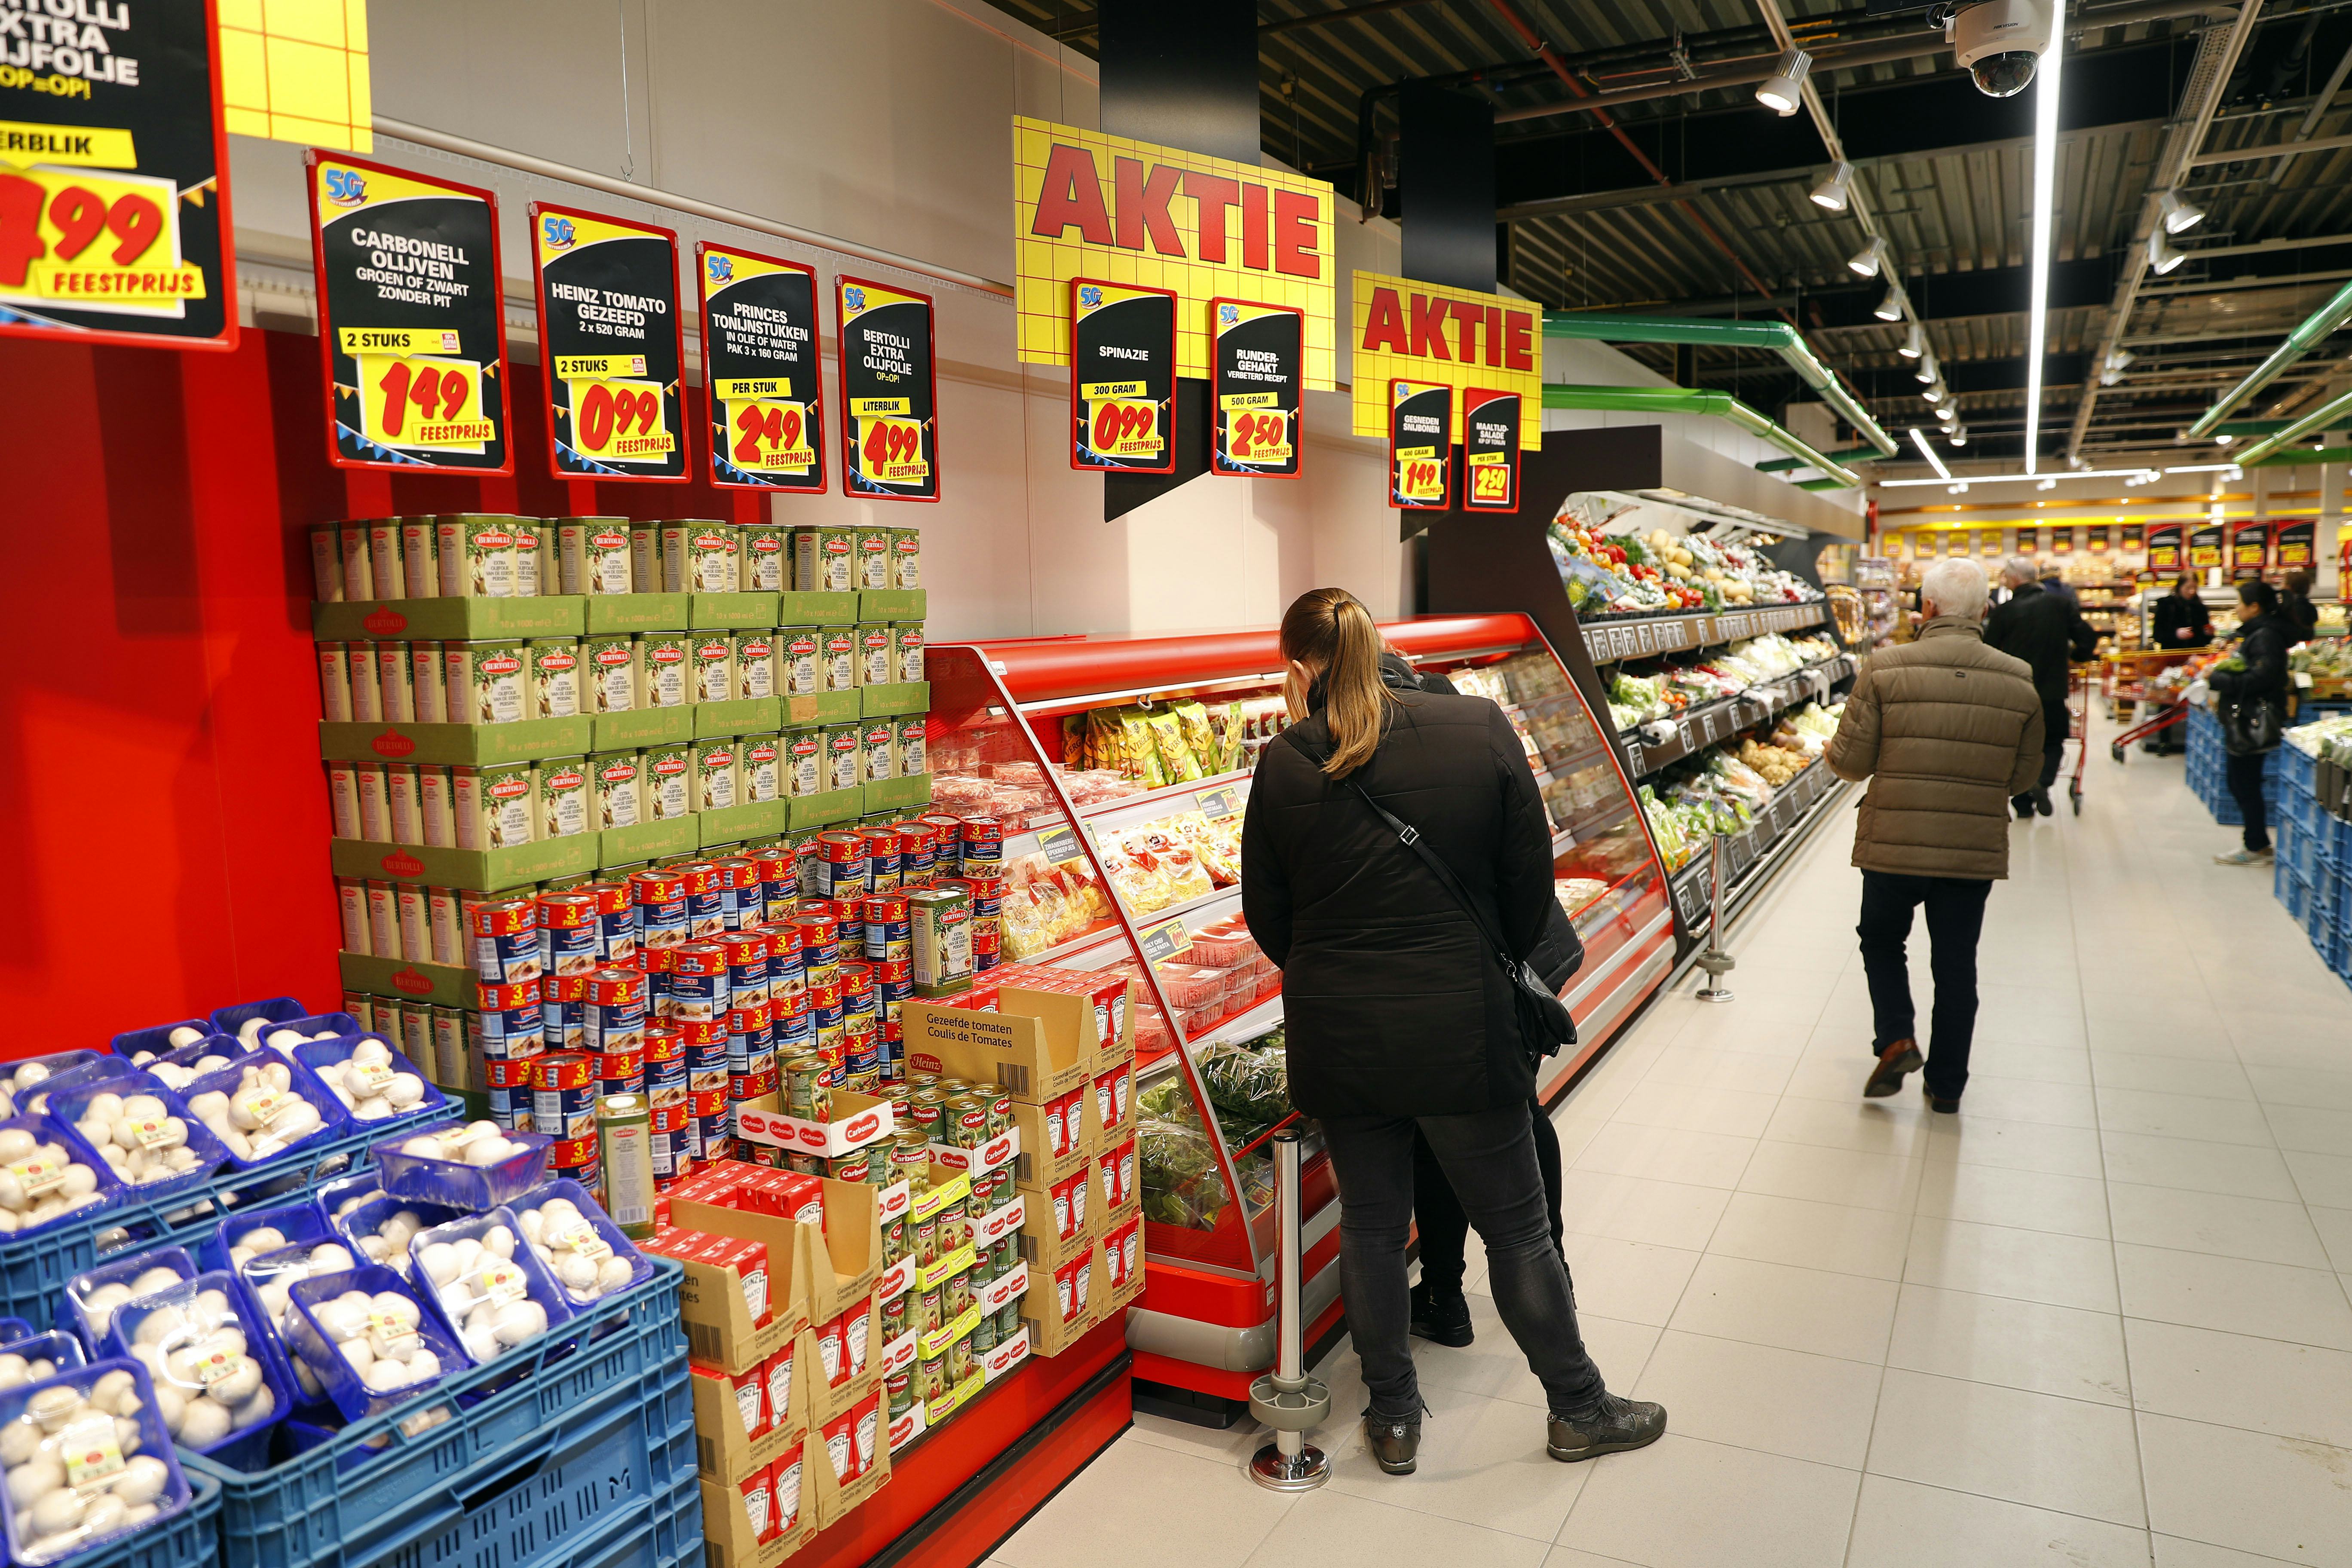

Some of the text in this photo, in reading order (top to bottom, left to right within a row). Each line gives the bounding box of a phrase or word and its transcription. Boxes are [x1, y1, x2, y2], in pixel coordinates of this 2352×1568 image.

[0, 3, 110, 54] XTRA
[0, 64, 91, 100] OP=OP!
[1031, 143, 1320, 277] AKTIE
[351, 227, 469, 265] CARBONELL
[371, 250, 454, 280] OLIJVEN
[54, 273, 194, 293] FEESTPRIJS
[356, 266, 469, 297] GROEN OF ZWART
[377, 285, 452, 308] ZONDER PIT
[551, 282, 666, 315] HEINZ TOMATO
[578, 303, 646, 327] GEZEEFD
[734, 303, 787, 324] PRINCES
[579, 321, 586, 332] 2
[596, 322, 613, 336] 520
[615, 325, 645, 339] GRAM
[712, 313, 808, 341] TONIJNSTUKKEN
[1362, 287, 1533, 371] AKTIE
[347, 333, 410, 347] 2 STUKS
[726, 331, 797, 351] IN OLIE OF WATER
[863, 329, 910, 349] BERTOLLI
[727, 343, 743, 355] PAK
[744, 346, 749, 356] 3
[758, 348, 772, 359] 160
[773, 349, 797, 362] GRAM
[870, 343, 905, 361] EXTRA
[1099, 346, 1148, 361] SPINAZIE
[1237, 349, 1280, 363] RUNDER-
[560, 360, 608, 373] 2 STUKS
[863, 355, 912, 375] OLIJFOLIE
[1238, 361, 1278, 374] GEHAKT
[876, 371, 900, 383] OP=OP!
[1227, 371, 1288, 383] VERBETERD RECEPT
[732, 381, 777, 393] PER STUK
[1094, 384, 1136, 395] 300 GRAM
[379, 361, 468, 437] 149
[863, 401, 900, 411] LITERBLIK
[1231, 396, 1268, 405] 500 GRAM
[579, 384, 658, 450] 099
[1404, 415, 1439, 426] GESNEDEN
[420, 423, 490, 441] FEESTPRIJS
[734, 405, 800, 462] 249
[1094, 403, 1153, 450] 099
[1231, 413, 1283, 456] 250
[1403, 423, 1440, 434] SNIJBONEN
[1476, 422, 1509, 433] MAALTIJD-
[1480, 431, 1504, 439] SALADE
[617, 437, 671, 453] FEESTPRIJS
[864, 421, 918, 475] 499
[1120, 440, 1161, 452] FEESTPRIJS
[1254, 447, 1290, 458] FEESTPRIJS
[766, 451, 812, 466] FEESTPRIJS
[889, 464, 926, 477] FEESTPRIJS
[1406, 462, 1436, 494] 149
[695, 538, 723, 547] BERTOLLI
[368, 617, 404, 628] BERTOLLI
[494, 784, 525, 794] BERTOLLI
[972, 825, 980, 835] 3
[1044, 838, 1074, 850] ZWANENBERG
[1047, 845, 1075, 857] SPEKREEPJES
[655, 883, 665, 895] 3
[659, 903, 683, 914] PRINCES
[943, 912, 965, 922] BERTOLLI
[1158, 942, 1170, 950] PASTA
[927, 1013, 1012, 1035] Gezeefde tomaten
[928, 1026, 1012, 1048] Coulis de Tomates
[912, 1057, 940, 1070] Heinz
[1053, 1079, 1064, 1087] Coulis
[742, 1119, 824, 1142] Carbonell Carbonell Carbonell
[848, 1121, 877, 1138] Carbonell
[986, 1144, 1008, 1161] Carbonell
[942, 1157, 966, 1167] Carbonell
[918, 1199, 939, 1214] Carbonell
[927, 1266, 947, 1282] Carbonell
[931, 1332, 953, 1349] Carbonell
[889, 1405, 906, 1413] ZONDER
